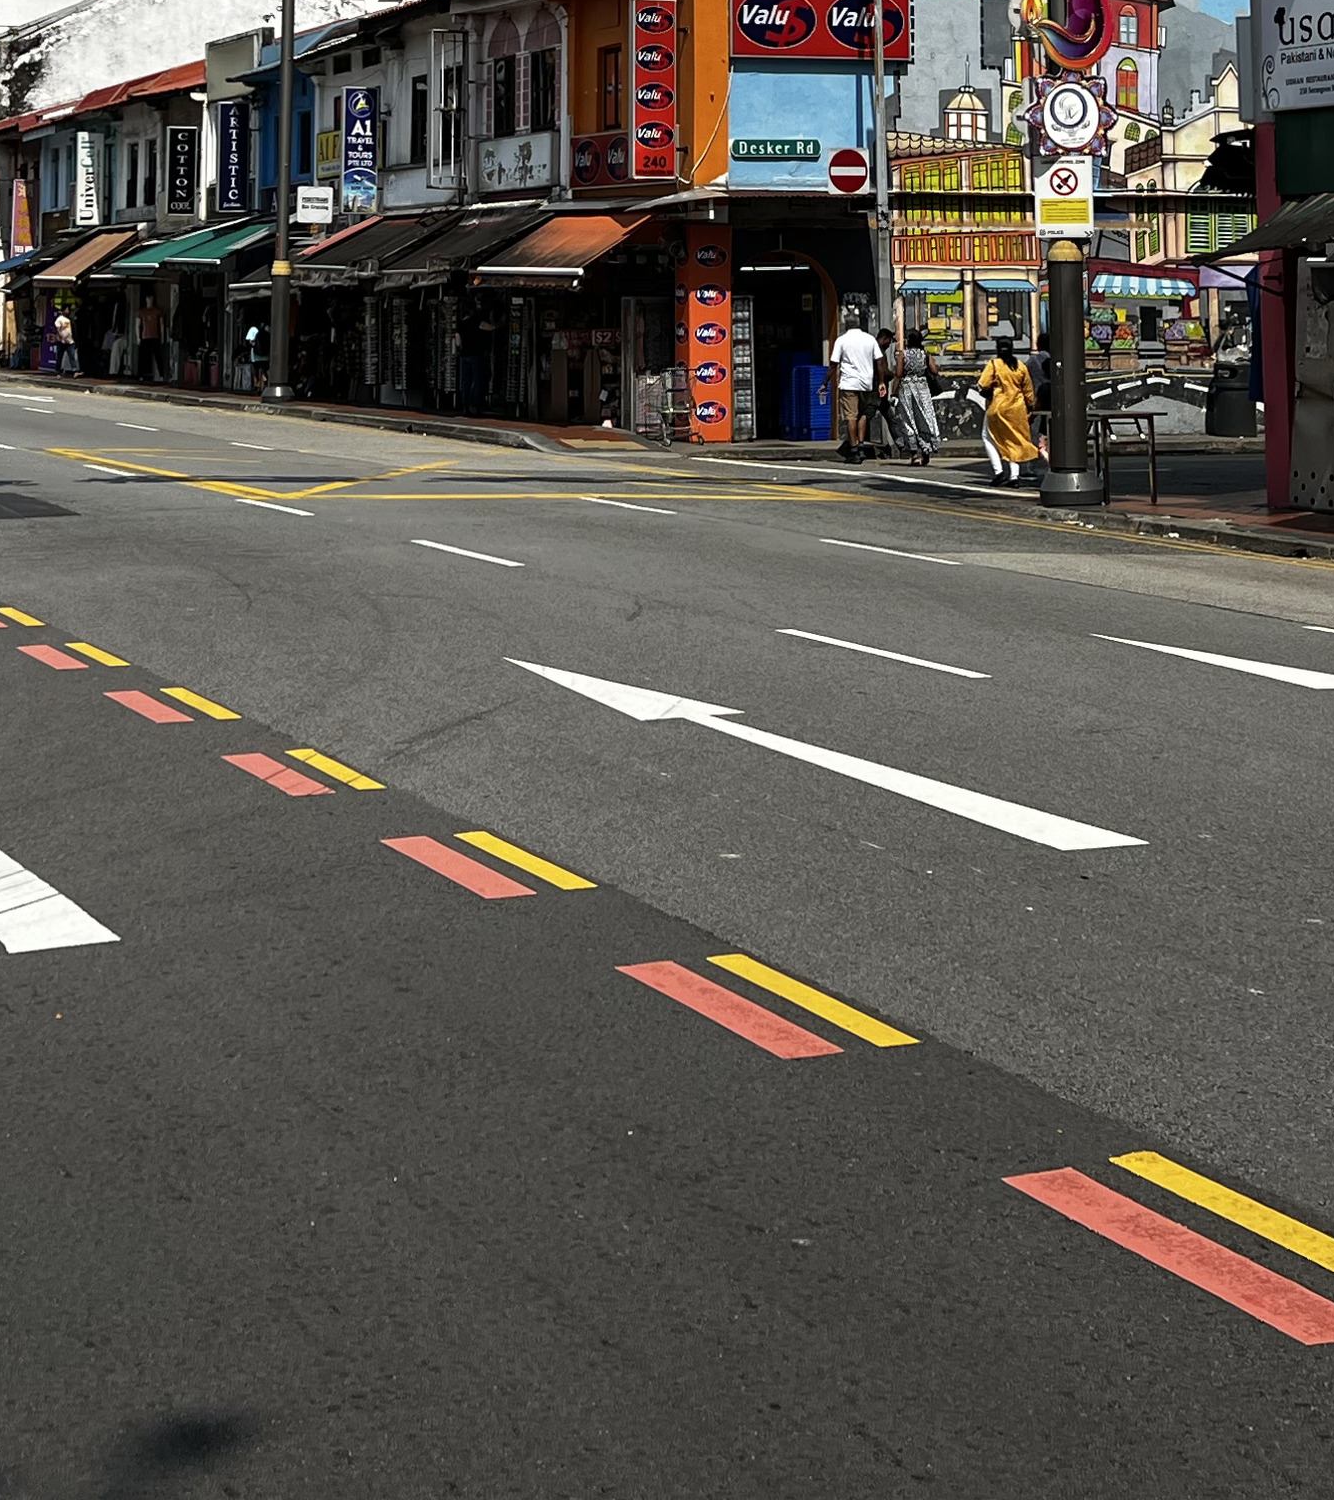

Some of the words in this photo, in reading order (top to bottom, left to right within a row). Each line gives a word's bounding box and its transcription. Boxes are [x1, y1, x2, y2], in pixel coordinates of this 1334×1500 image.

[1280, 51, 1317, 65] Pakistani
[1318, 49, 1325, 60] &
[351, 119, 373, 137] A1
[347, 136, 375, 145] TRAVEL
[738, 141, 790, 155] Desker
[796, 141, 814, 155] Rd
[228, 106, 240, 200] ARTISTIC
[347, 151, 373, 160] TOURS
[175, 132, 190, 199] COTTON
[642, 156, 667, 169] 240
[80, 139, 95, 222] UniverCell
